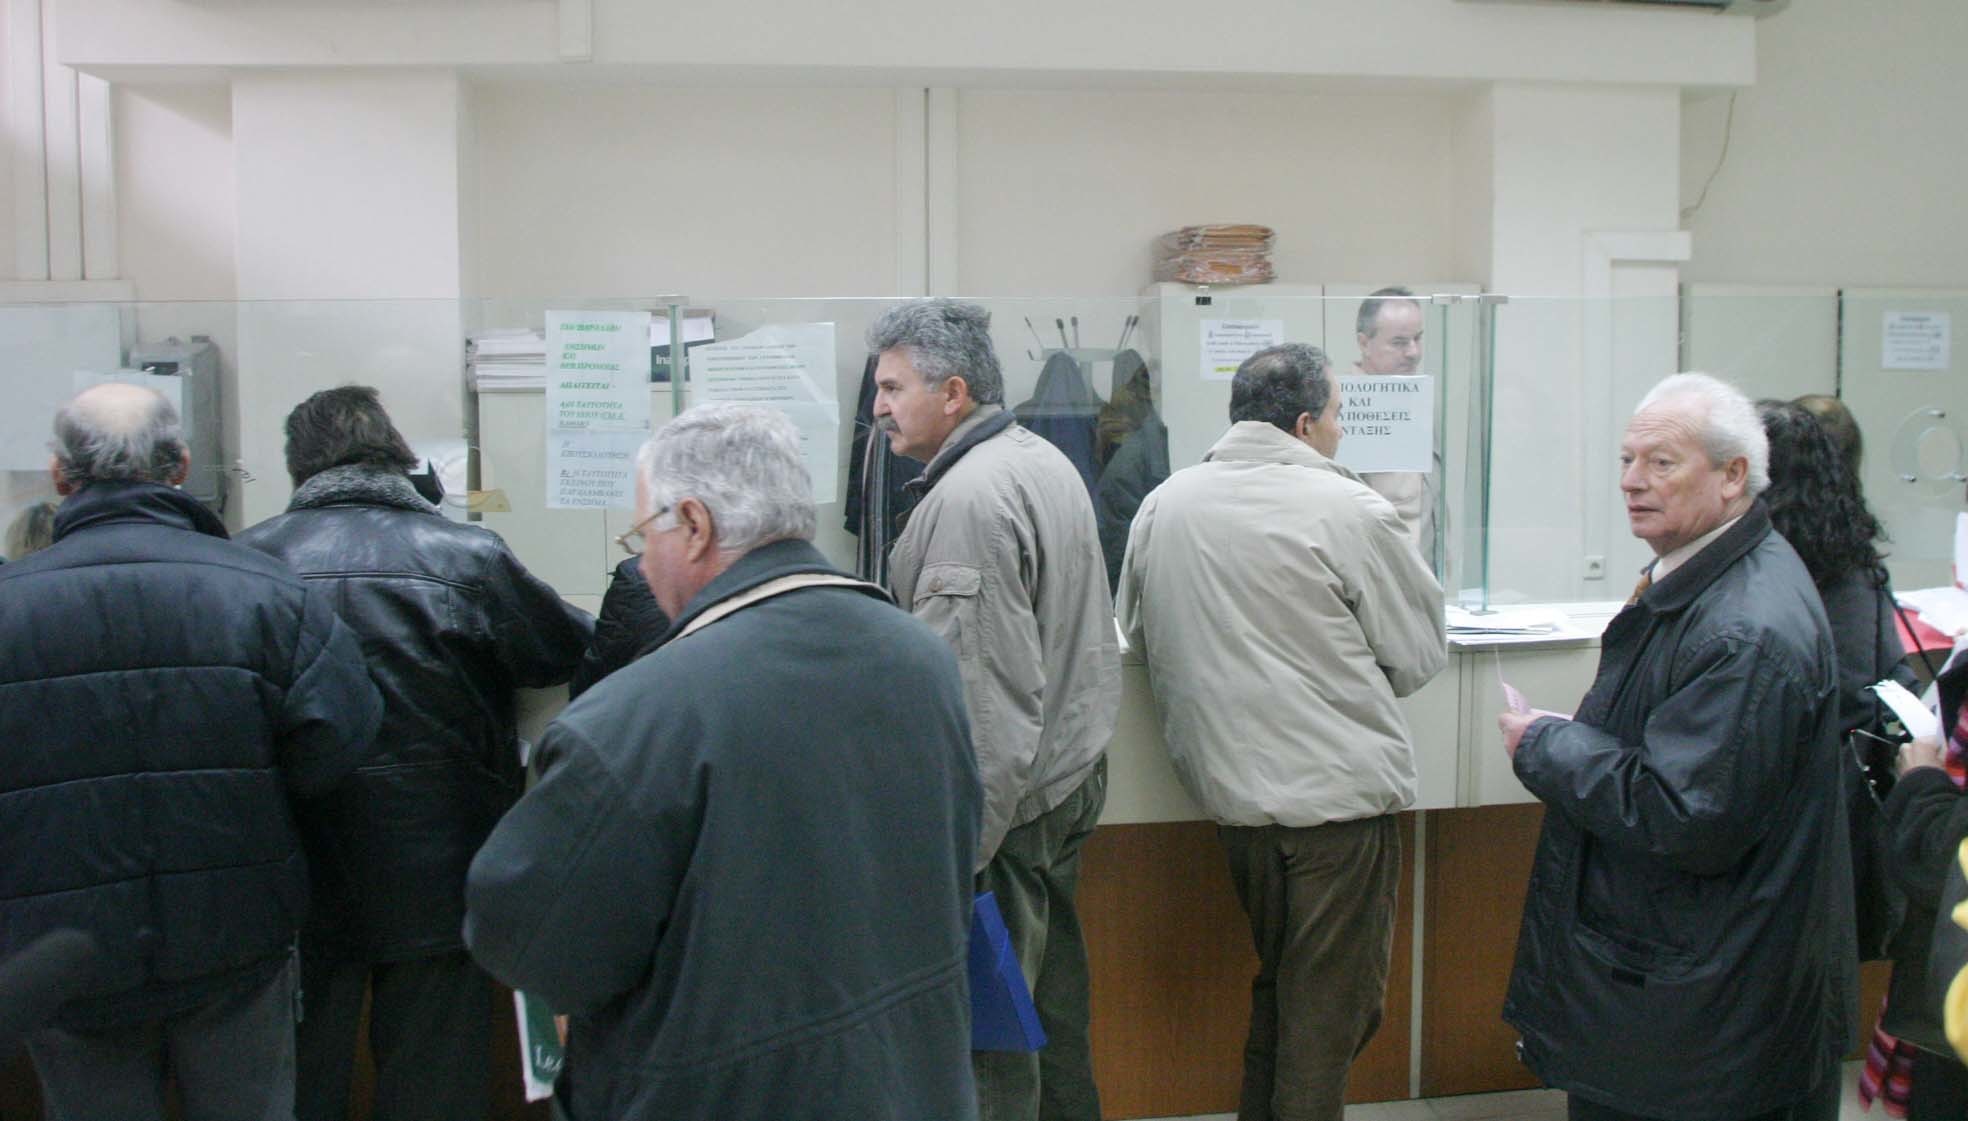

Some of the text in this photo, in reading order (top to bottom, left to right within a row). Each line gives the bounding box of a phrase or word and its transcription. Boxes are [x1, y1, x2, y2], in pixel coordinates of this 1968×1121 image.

[1340, 383, 1420, 393] ΙΟΛΟΓΗΤΙΚΑ
[1349, 397, 1372, 407] ΚΑΙ
[1341, 426, 1392, 436] ΝΤΑΞΗΣ
